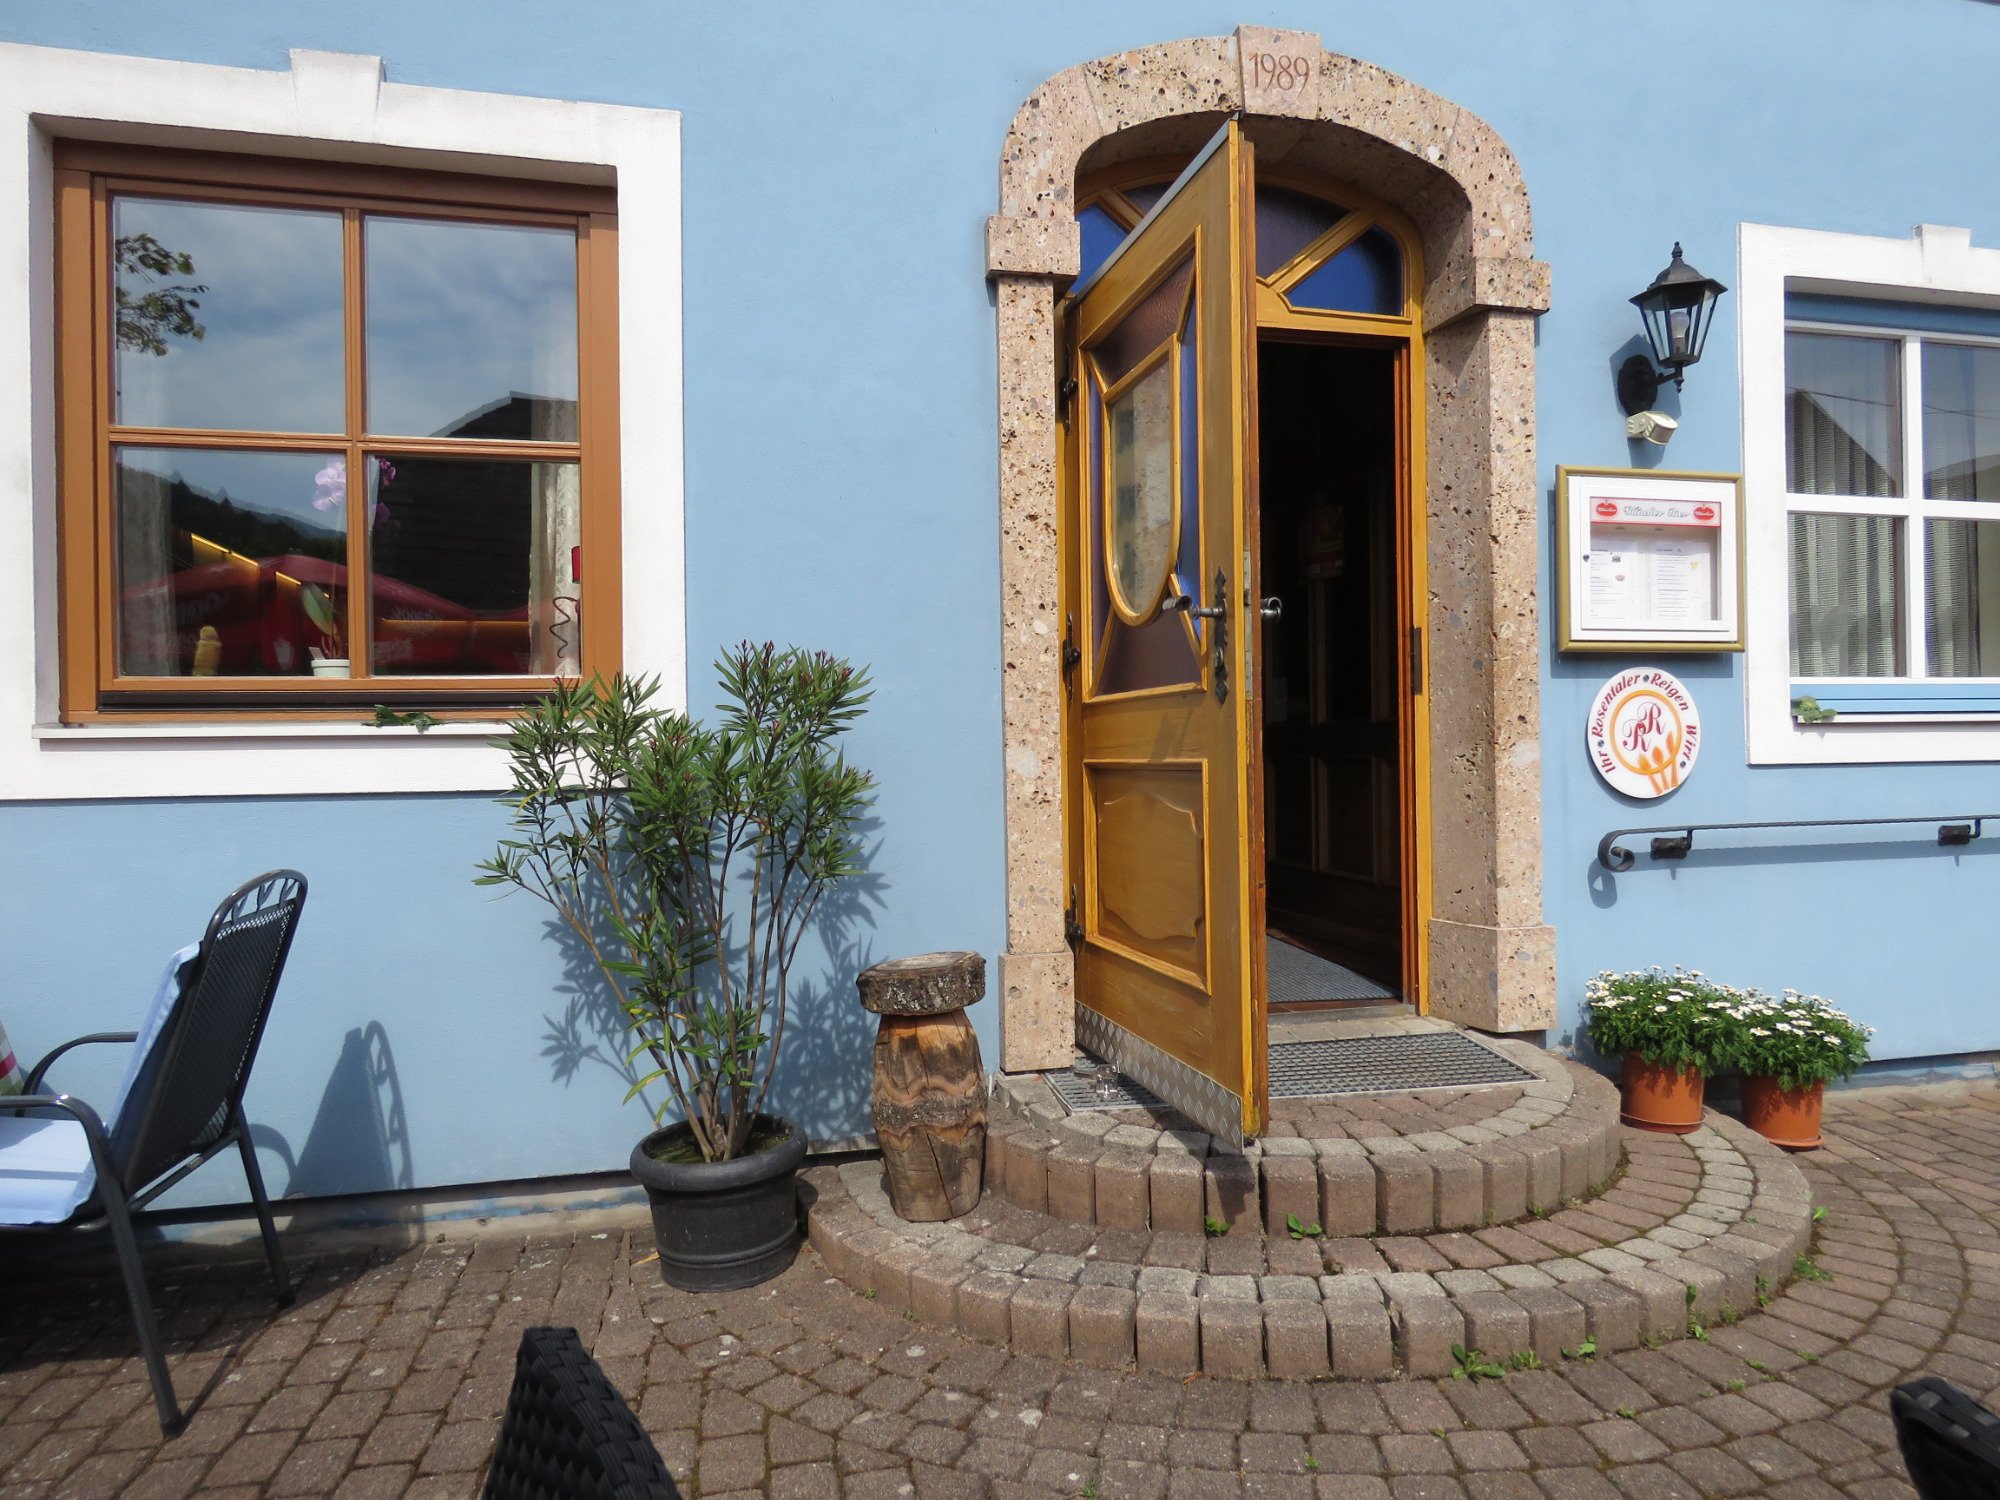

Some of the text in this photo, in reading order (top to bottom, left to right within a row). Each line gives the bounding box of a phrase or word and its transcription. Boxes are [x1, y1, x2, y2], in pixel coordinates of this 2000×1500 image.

[1248, 52, 1310, 98] 1989
[1591, 673, 1698, 774] Ihr Rosentaler Reigen Wirt
